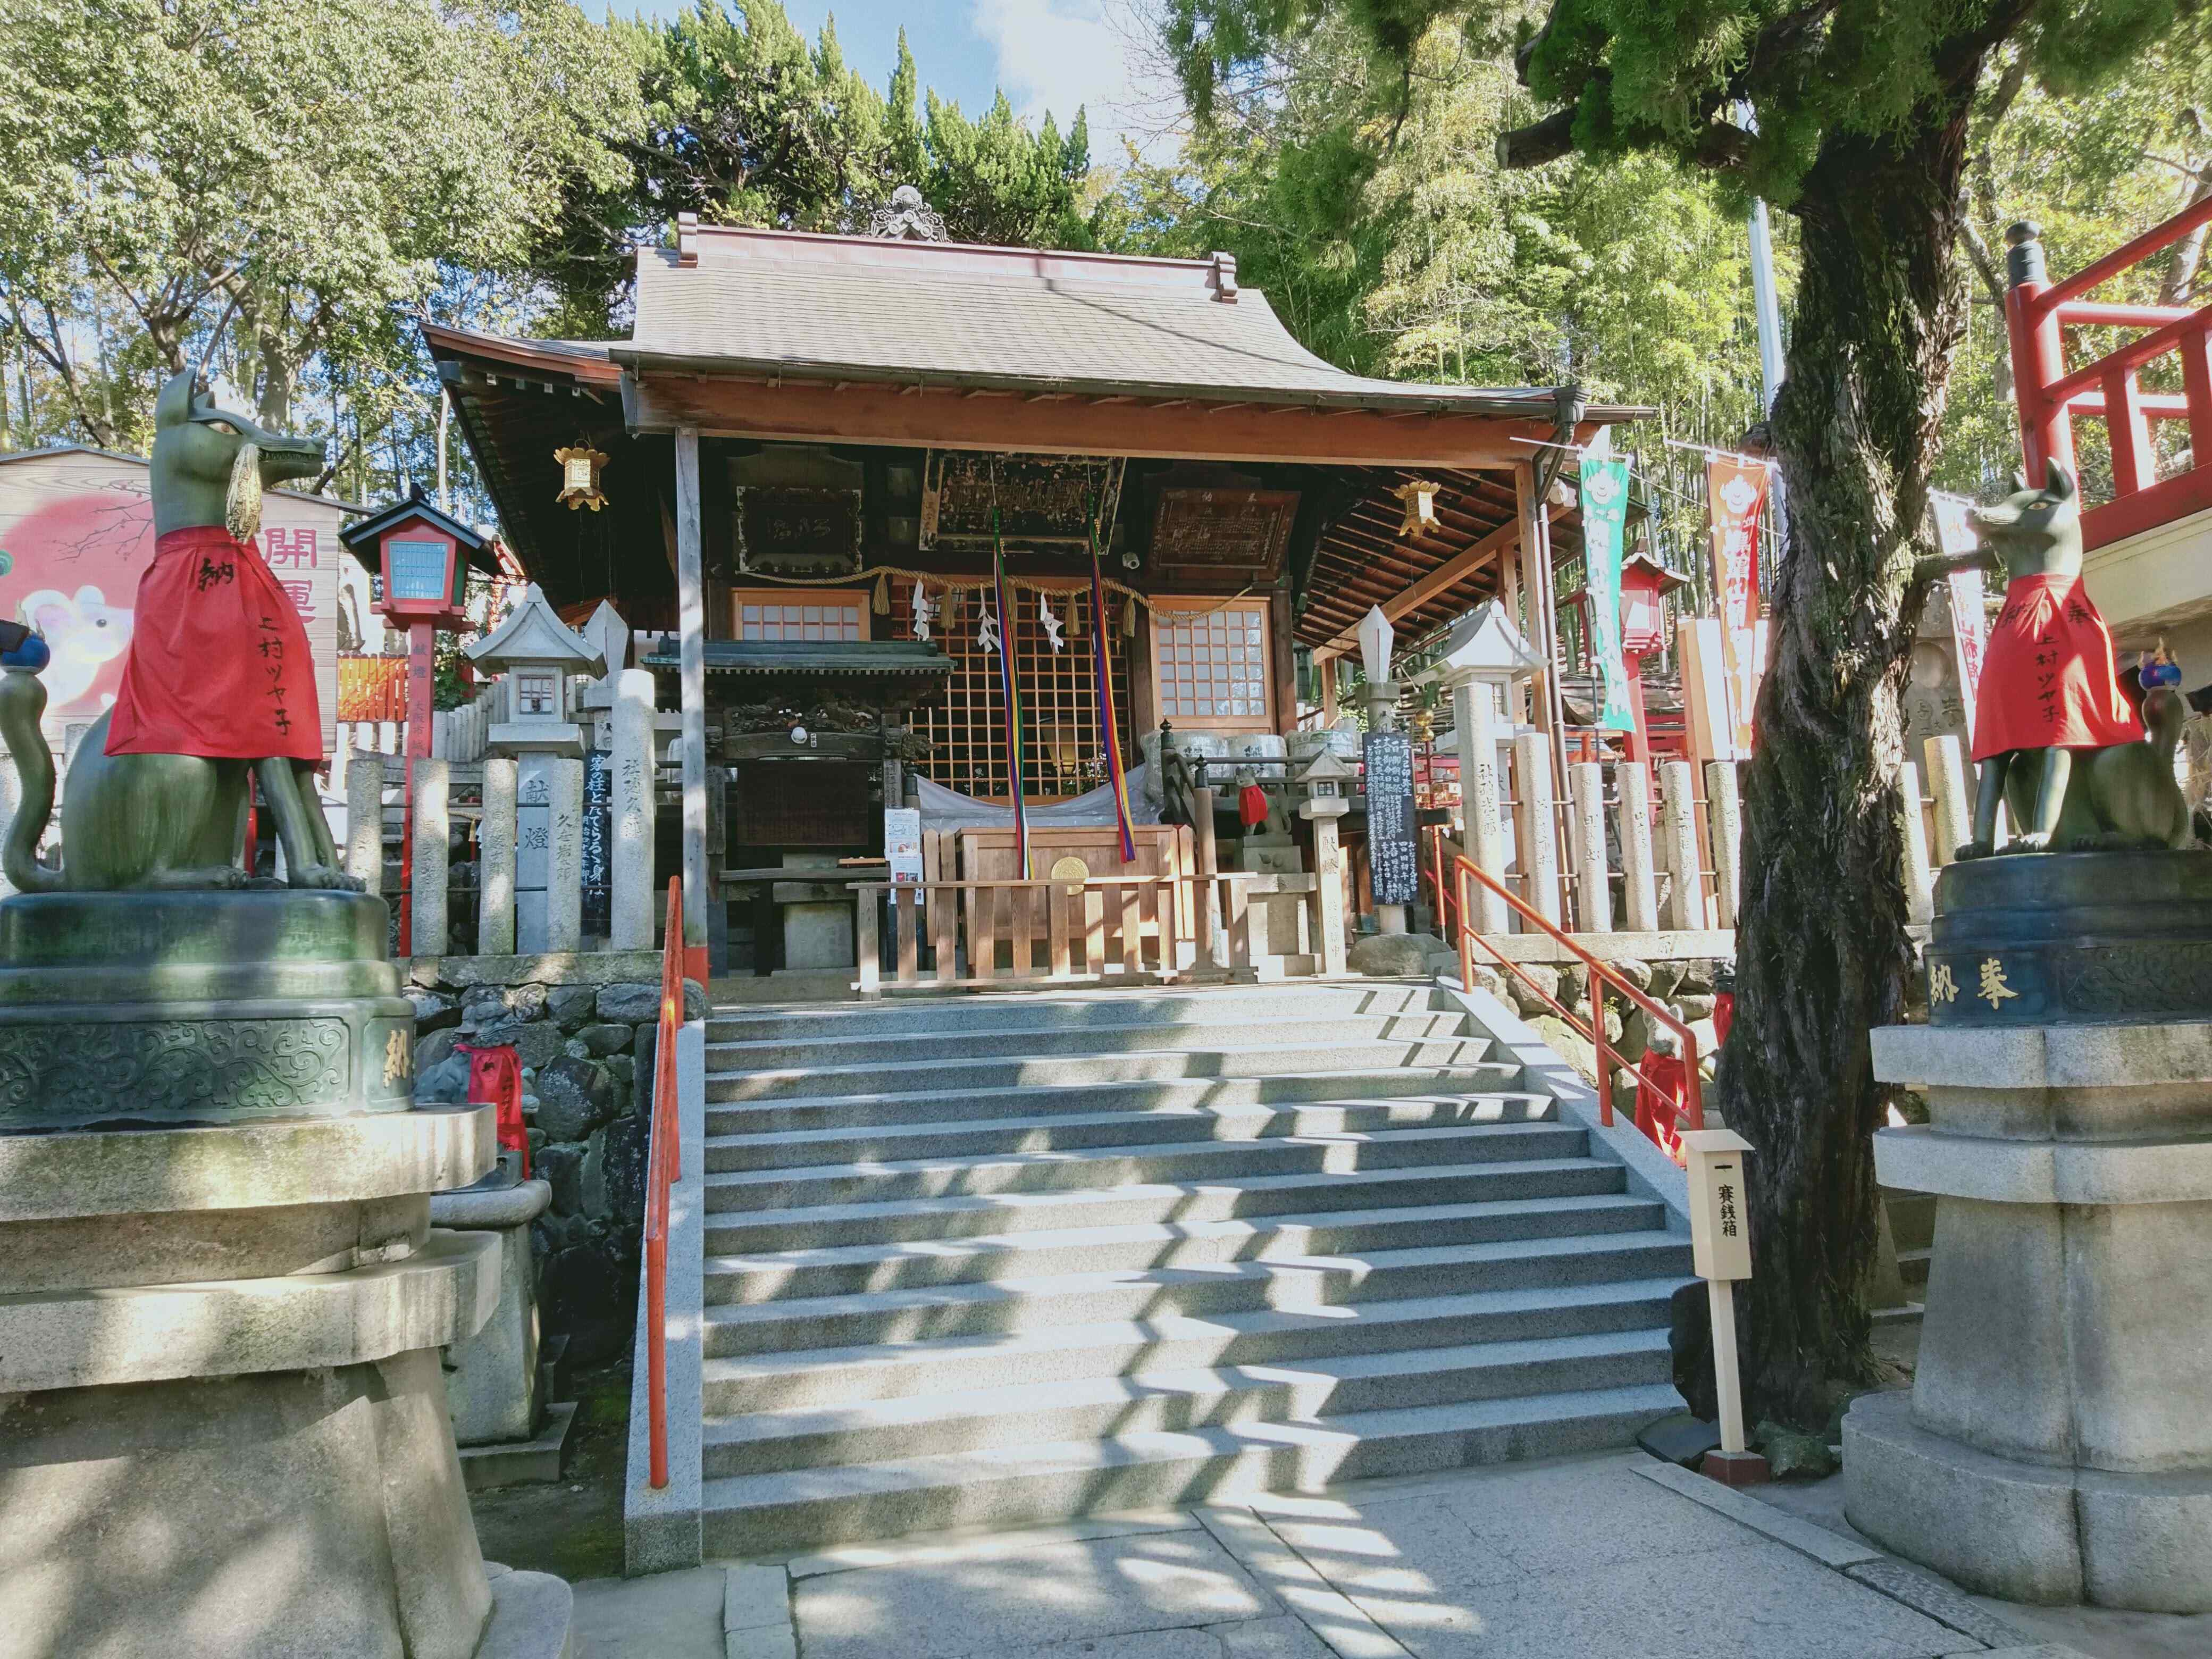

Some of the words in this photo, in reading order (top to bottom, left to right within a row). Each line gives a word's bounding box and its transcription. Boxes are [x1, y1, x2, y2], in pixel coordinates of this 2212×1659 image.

[199, 557, 234, 591] 納
[263, 527, 317, 655] 開運
[2035, 633, 2060, 723] 上村ツヤ子
[524, 780, 549, 850] 献燈
[1718, 1184, 1737, 1238] 賽銭箱
